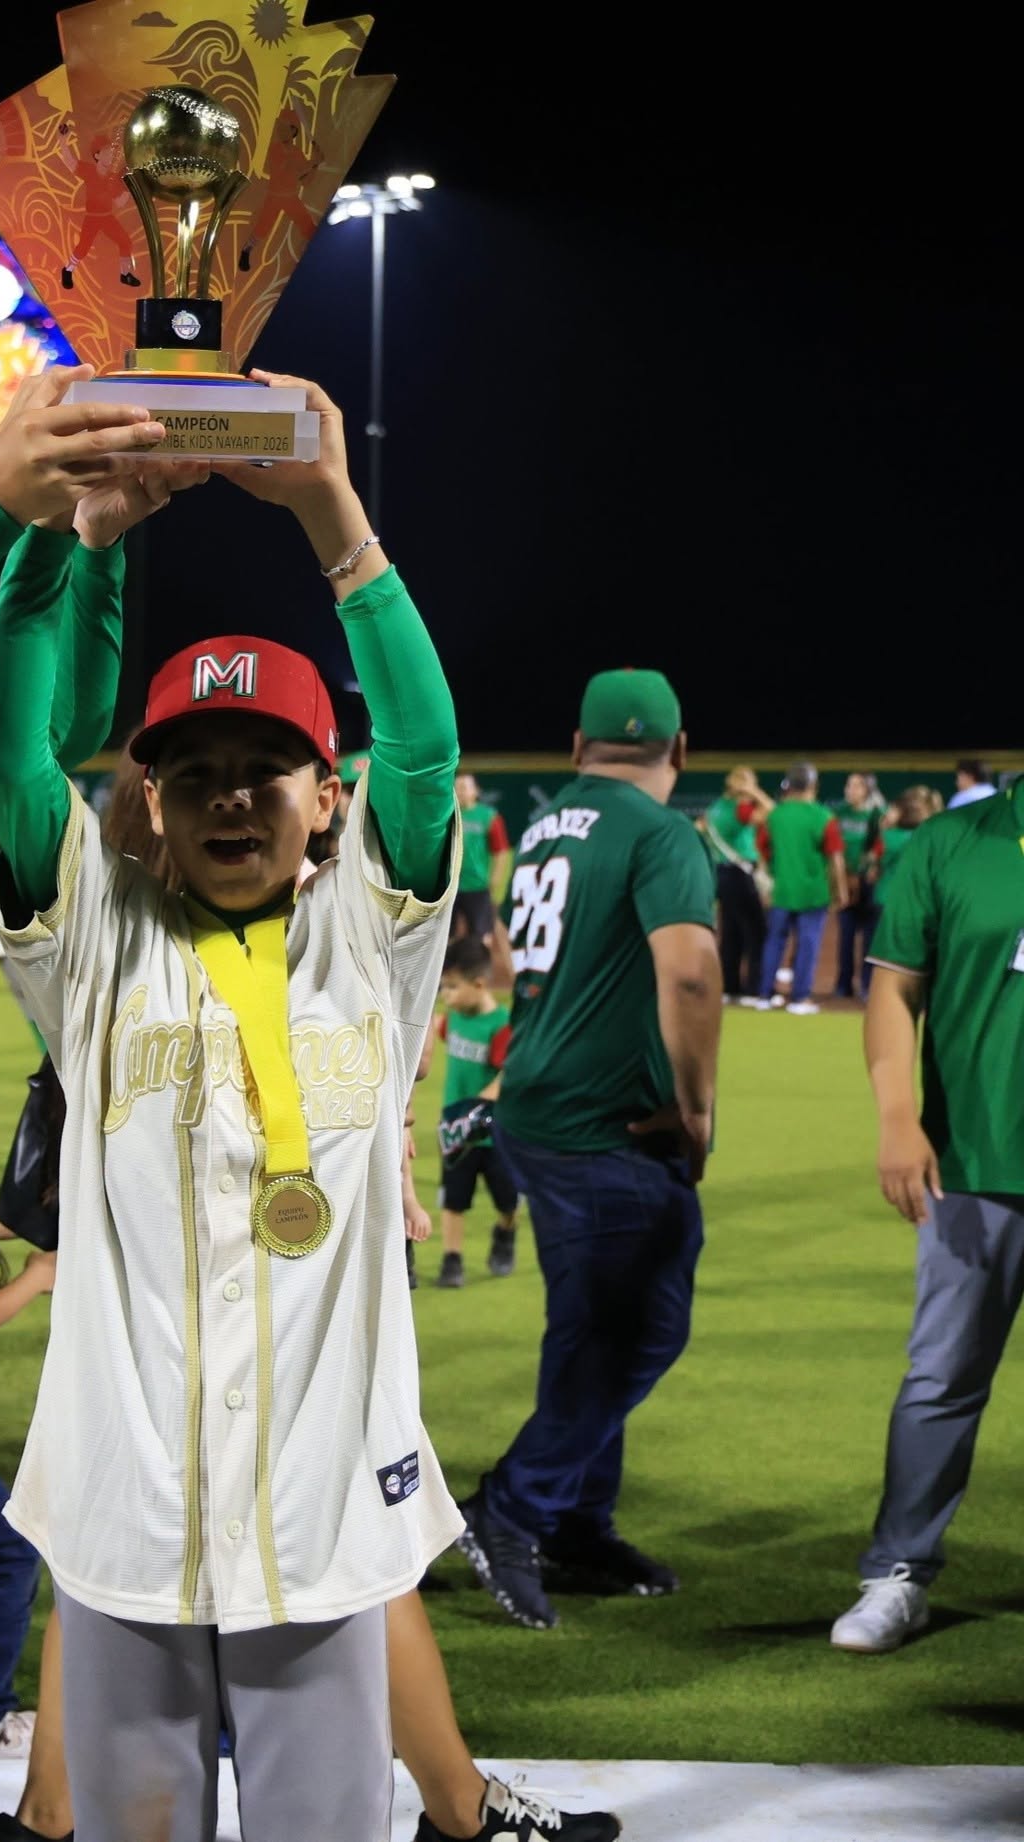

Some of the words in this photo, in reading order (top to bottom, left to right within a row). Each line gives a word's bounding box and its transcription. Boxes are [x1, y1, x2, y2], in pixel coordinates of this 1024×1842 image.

[189, 435, 213, 449] KIDS
[216, 436, 260, 450] NAYARIT
[263, 436, 289, 451] 2026
[192, 652, 258, 701] M
[508, 855, 570, 973] 28
